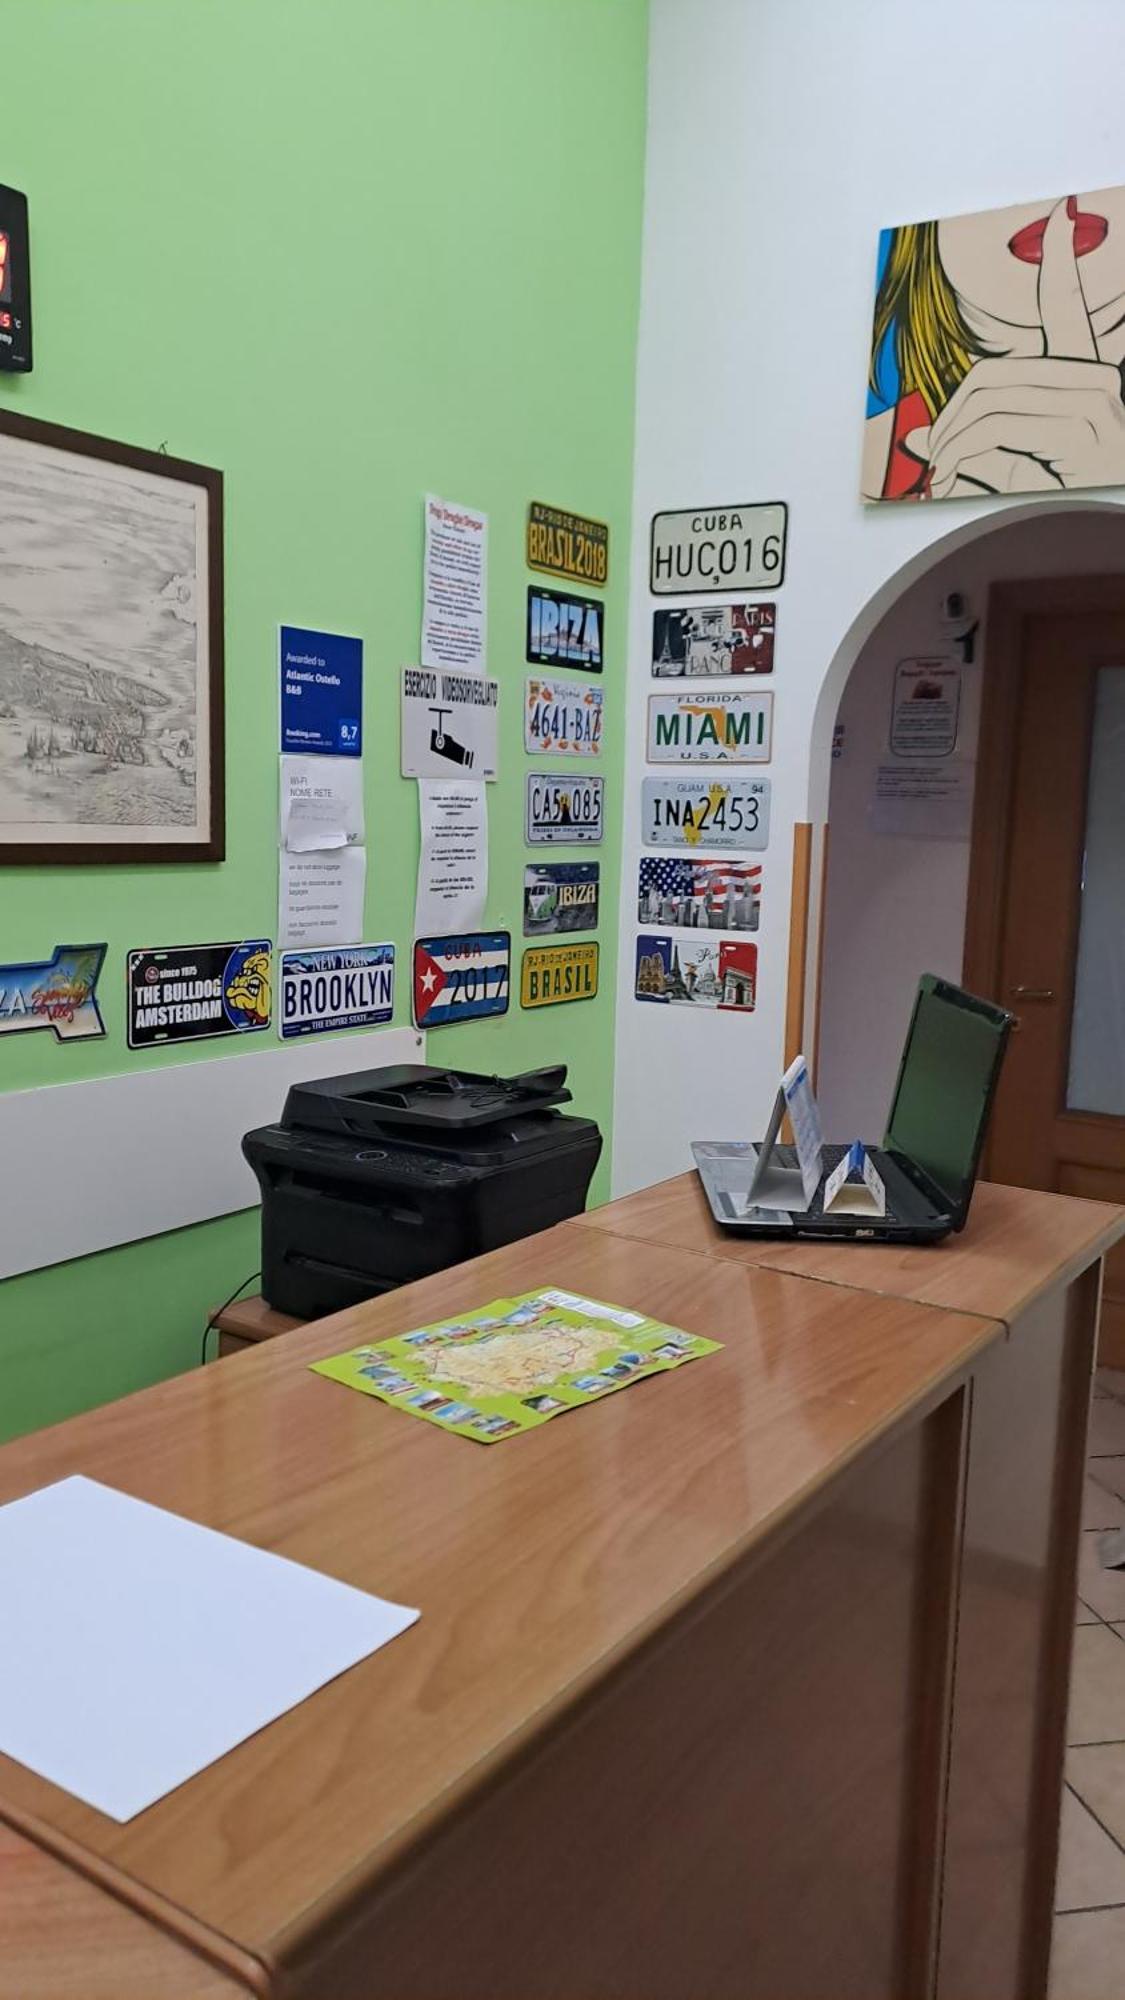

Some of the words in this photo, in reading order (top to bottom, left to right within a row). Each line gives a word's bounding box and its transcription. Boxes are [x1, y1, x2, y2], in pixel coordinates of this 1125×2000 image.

[691, 513, 743, 533] CUBA
[531, 596, 601, 664] IBIZA
[286, 652, 317, 666] Awarded
[318, 658, 326, 667] to
[286, 669, 314, 682] Atlantic
[286, 684, 302, 695] B&B
[677, 695, 742, 704] FLORIDA
[341, 725, 358, 741] 8,7
[656, 711, 764, 746] MIAMI
[677, 783, 705, 793] GUAM
[751, 784, 764, 794] 94
[559, 884, 596, 906] IBIZA
[312, 954, 337, 972] NEW
[339, 950, 369, 970] YORK
[444, 943, 482, 961] CUBA
[160, 968, 181, 979] since
[530, 964, 592, 1000] BRASIL
[135, 985, 161, 1006] THE
[163, 978, 222, 1003] BULLDOG
[285, 969, 392, 1018] BROOKLYN
[450, 964, 507, 1006] 2017
[135, 999, 222, 1029] AMSTERDAM
[312, 1020, 325, 1030] THE
[325, 1016, 348, 1028] EMPIRE
[349, 1013, 367, 1025] STATE
